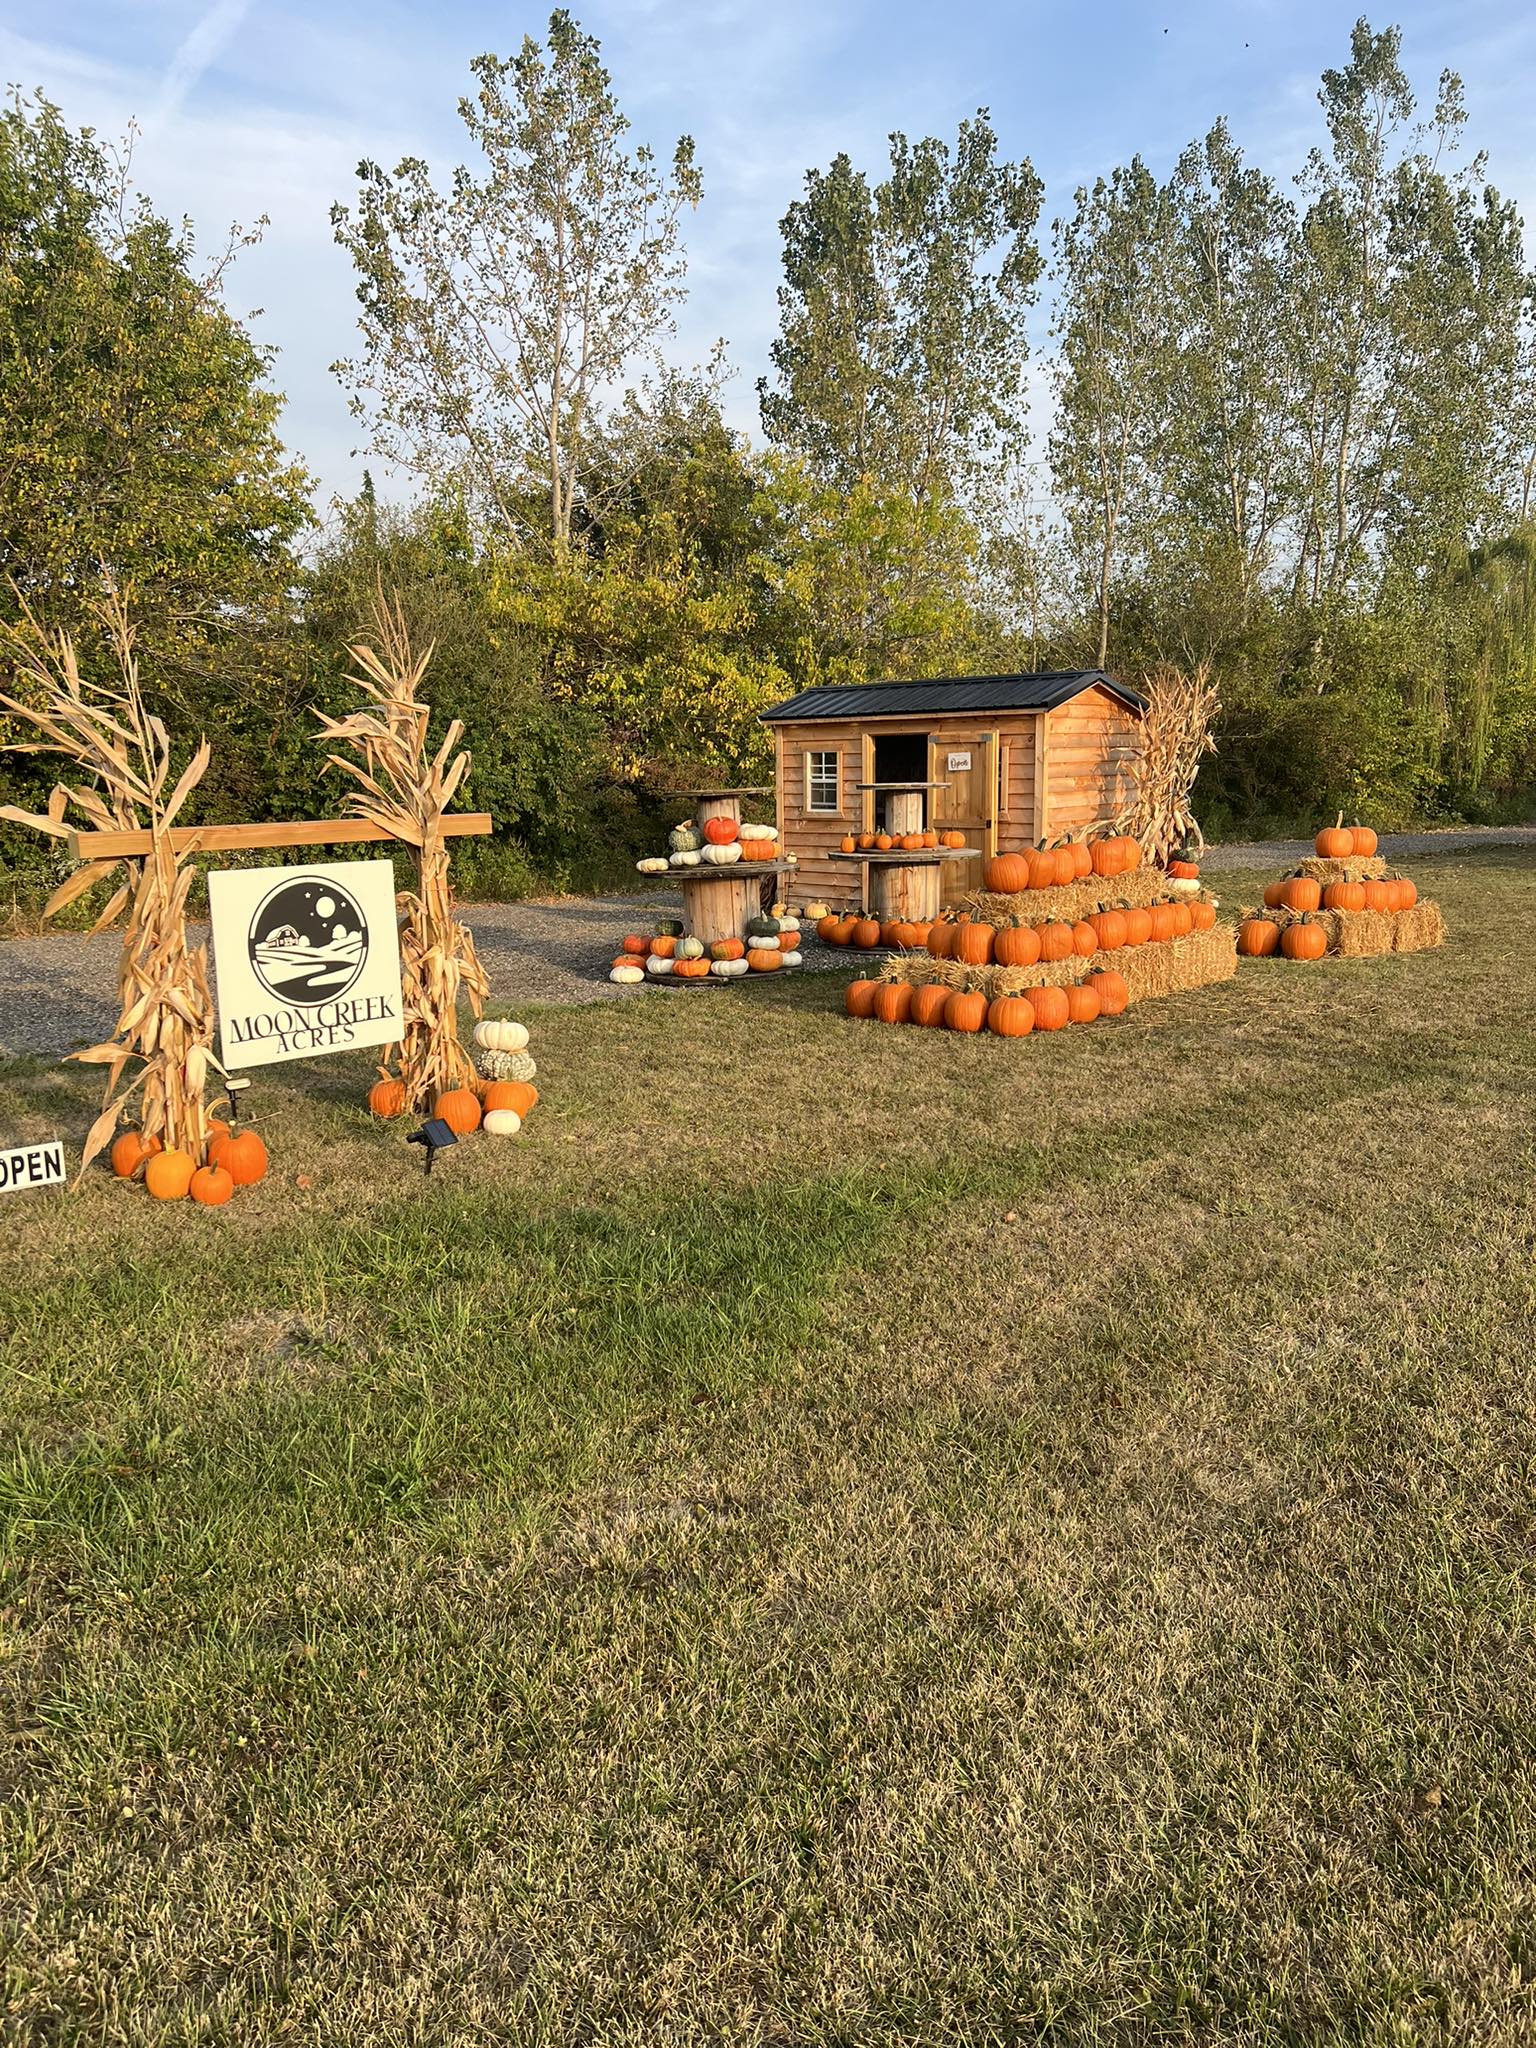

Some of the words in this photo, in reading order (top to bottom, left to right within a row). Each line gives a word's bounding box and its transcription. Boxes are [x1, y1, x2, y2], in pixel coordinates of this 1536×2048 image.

[951, 758, 968, 769] Open
[230, 1008, 310, 1044] MOON
[317, 995, 395, 1028] CREEK
[276, 1025, 355, 1053] ACRES
